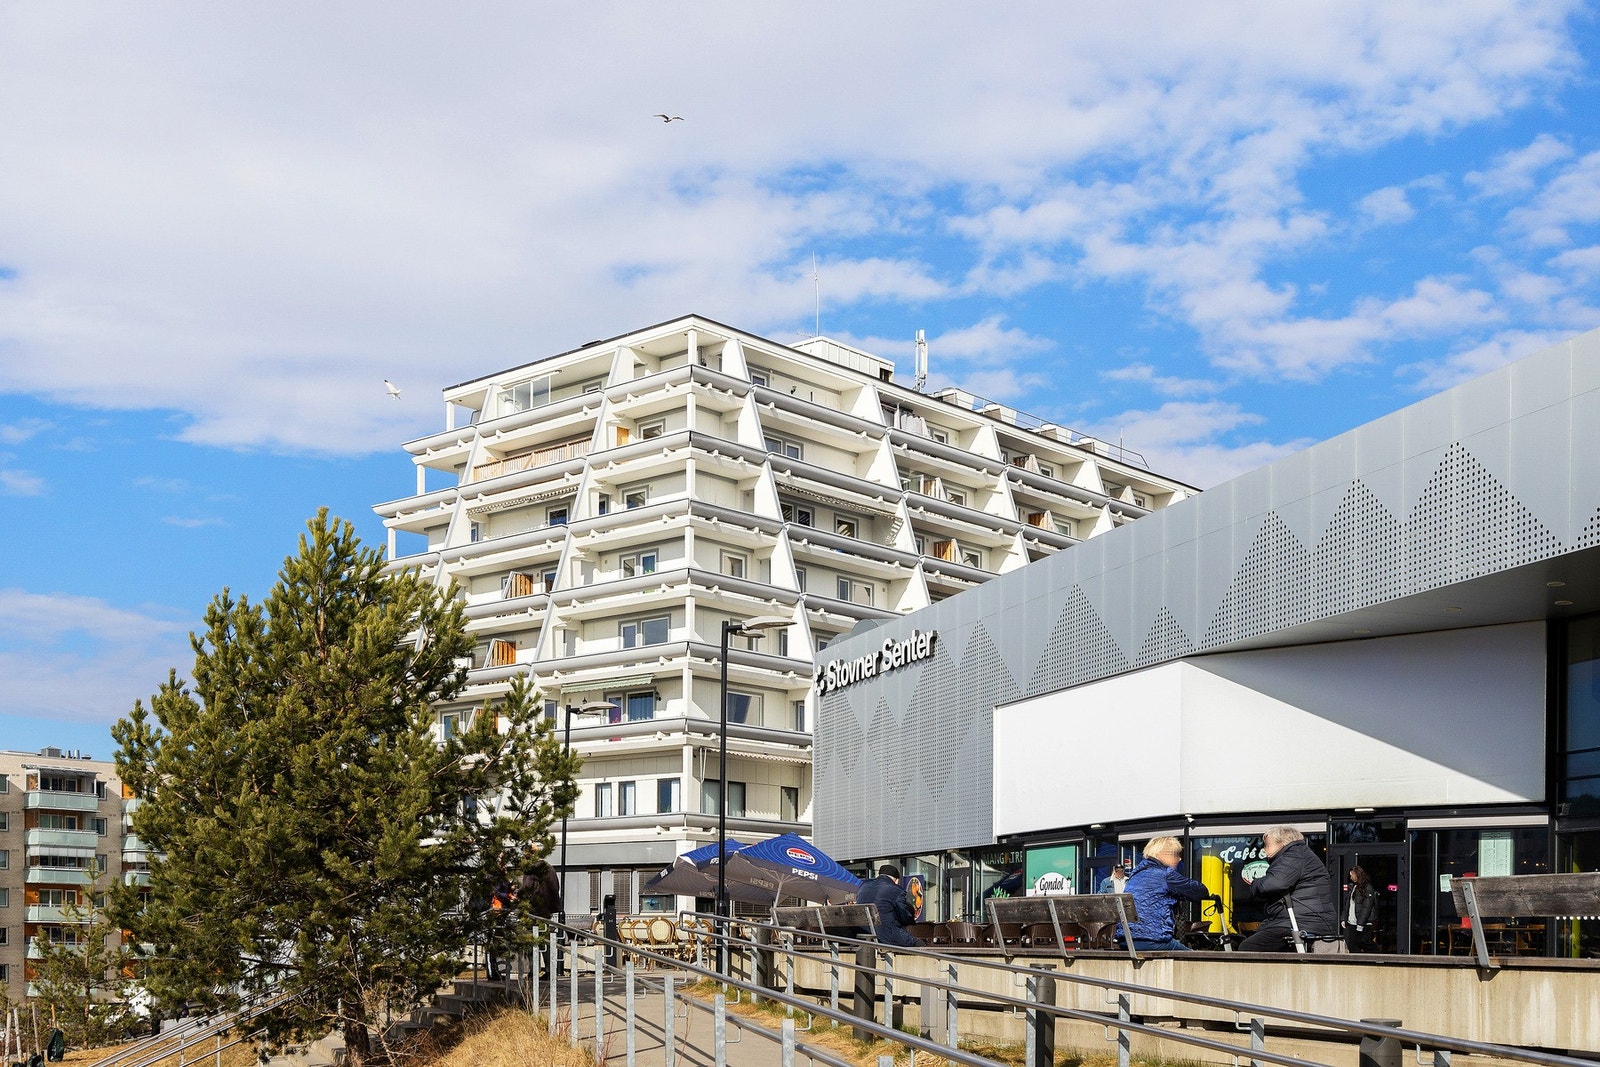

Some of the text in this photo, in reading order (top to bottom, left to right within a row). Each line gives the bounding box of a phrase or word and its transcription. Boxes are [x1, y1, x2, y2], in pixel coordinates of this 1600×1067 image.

[826, 629, 936, 691] Stovner Senter
[1220, 846, 1256, 864] Café
[791, 867, 819, 881] PEPSI
